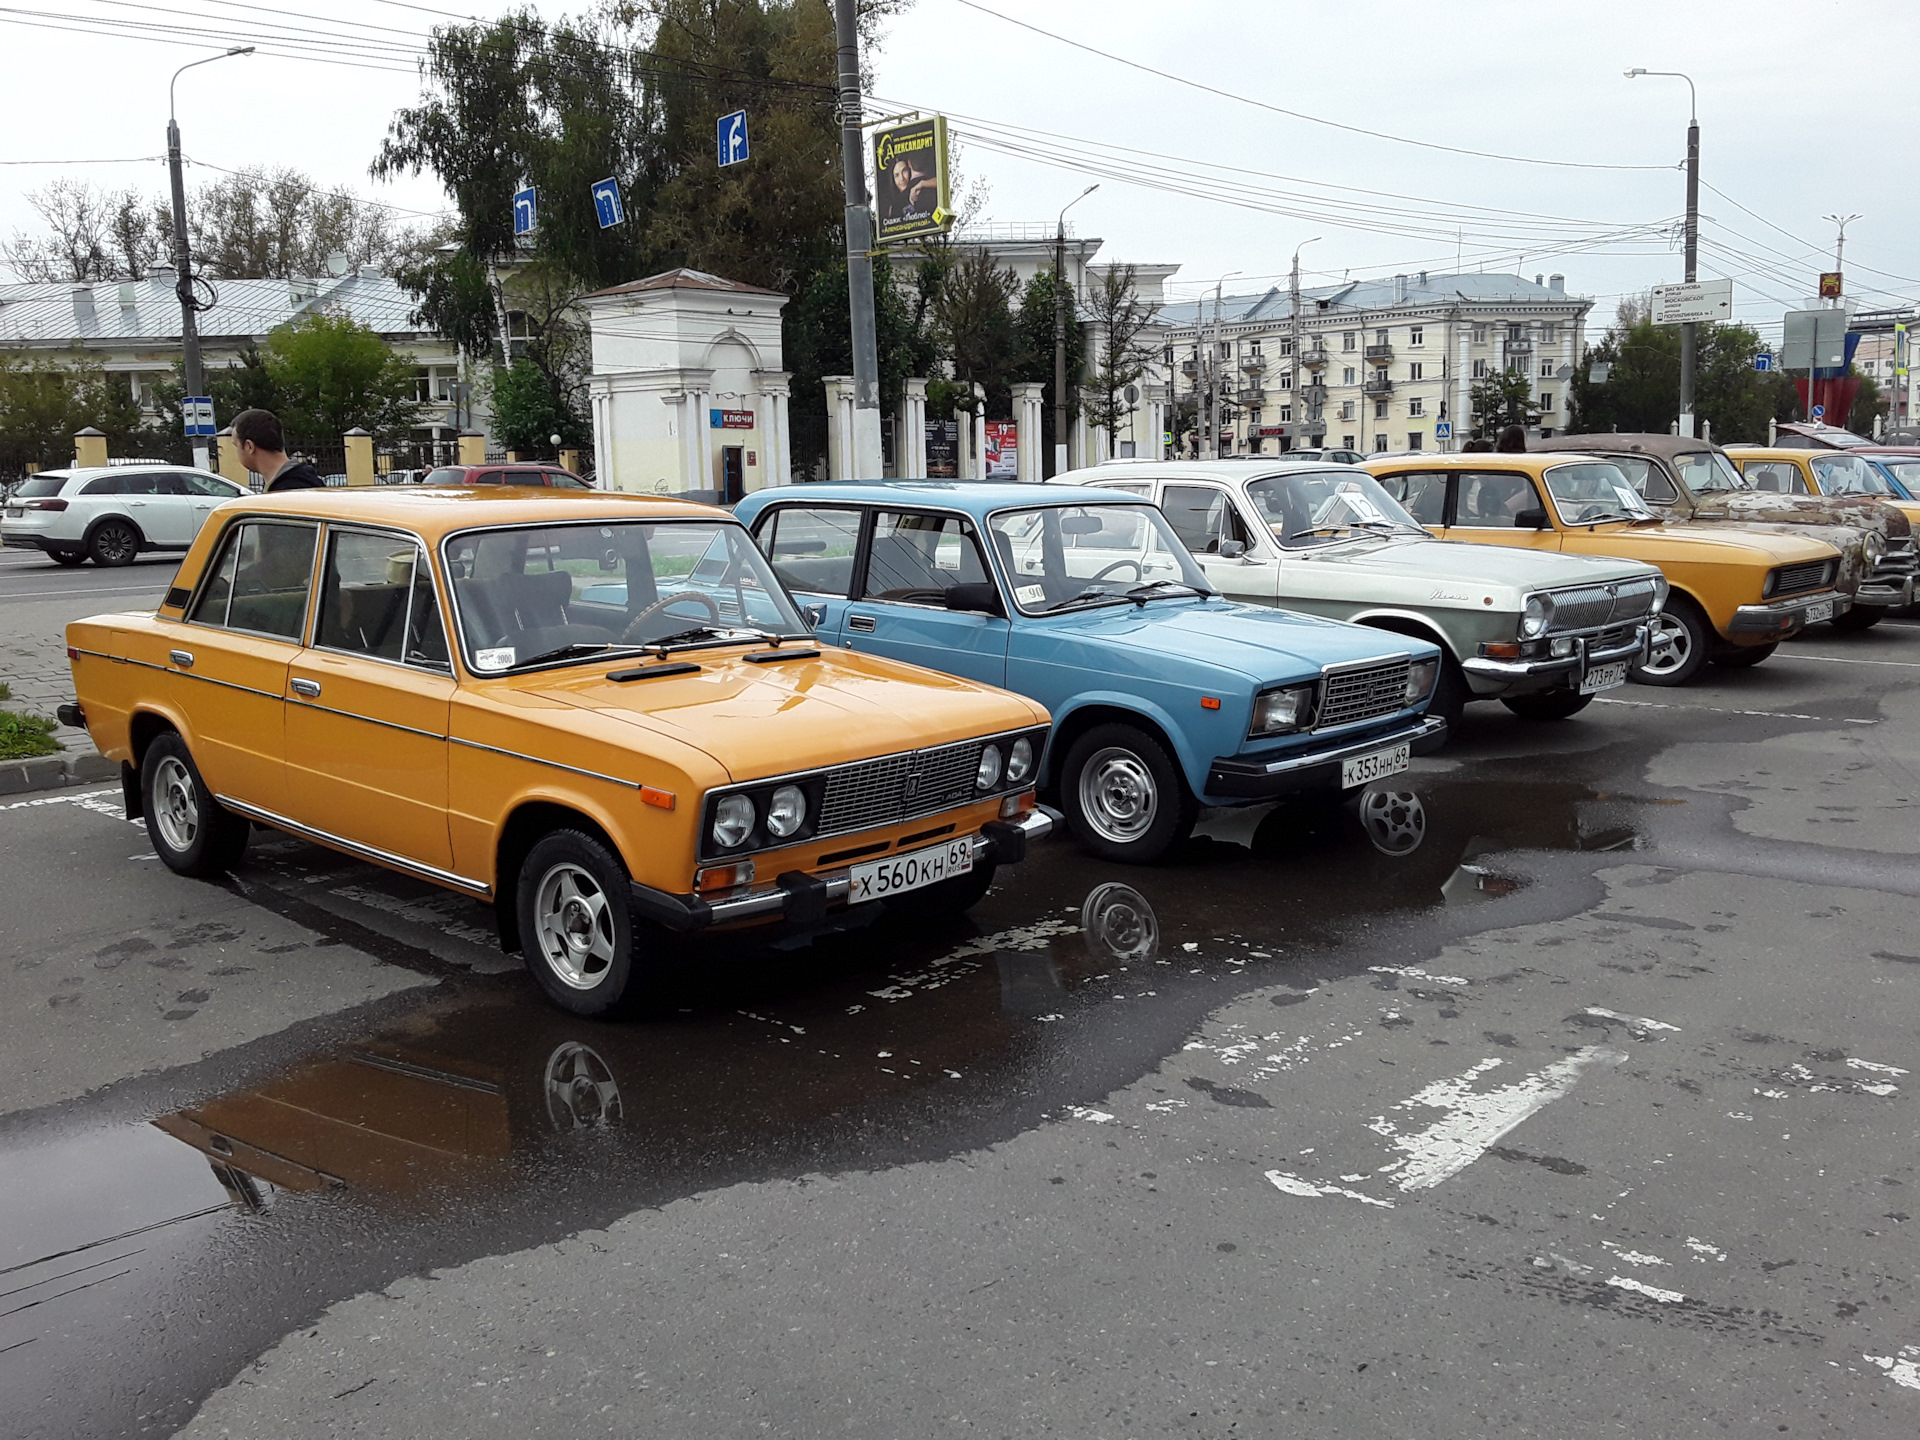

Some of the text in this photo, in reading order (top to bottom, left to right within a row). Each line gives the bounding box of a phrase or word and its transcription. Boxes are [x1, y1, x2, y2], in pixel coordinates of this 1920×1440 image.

[1665, 284, 1701, 293] ВАГЖАНОВА
[723, 414, 753, 424] КЛЮЧИ
[998, 424, 1008, 435] 19
[949, 842, 967, 865] 69
